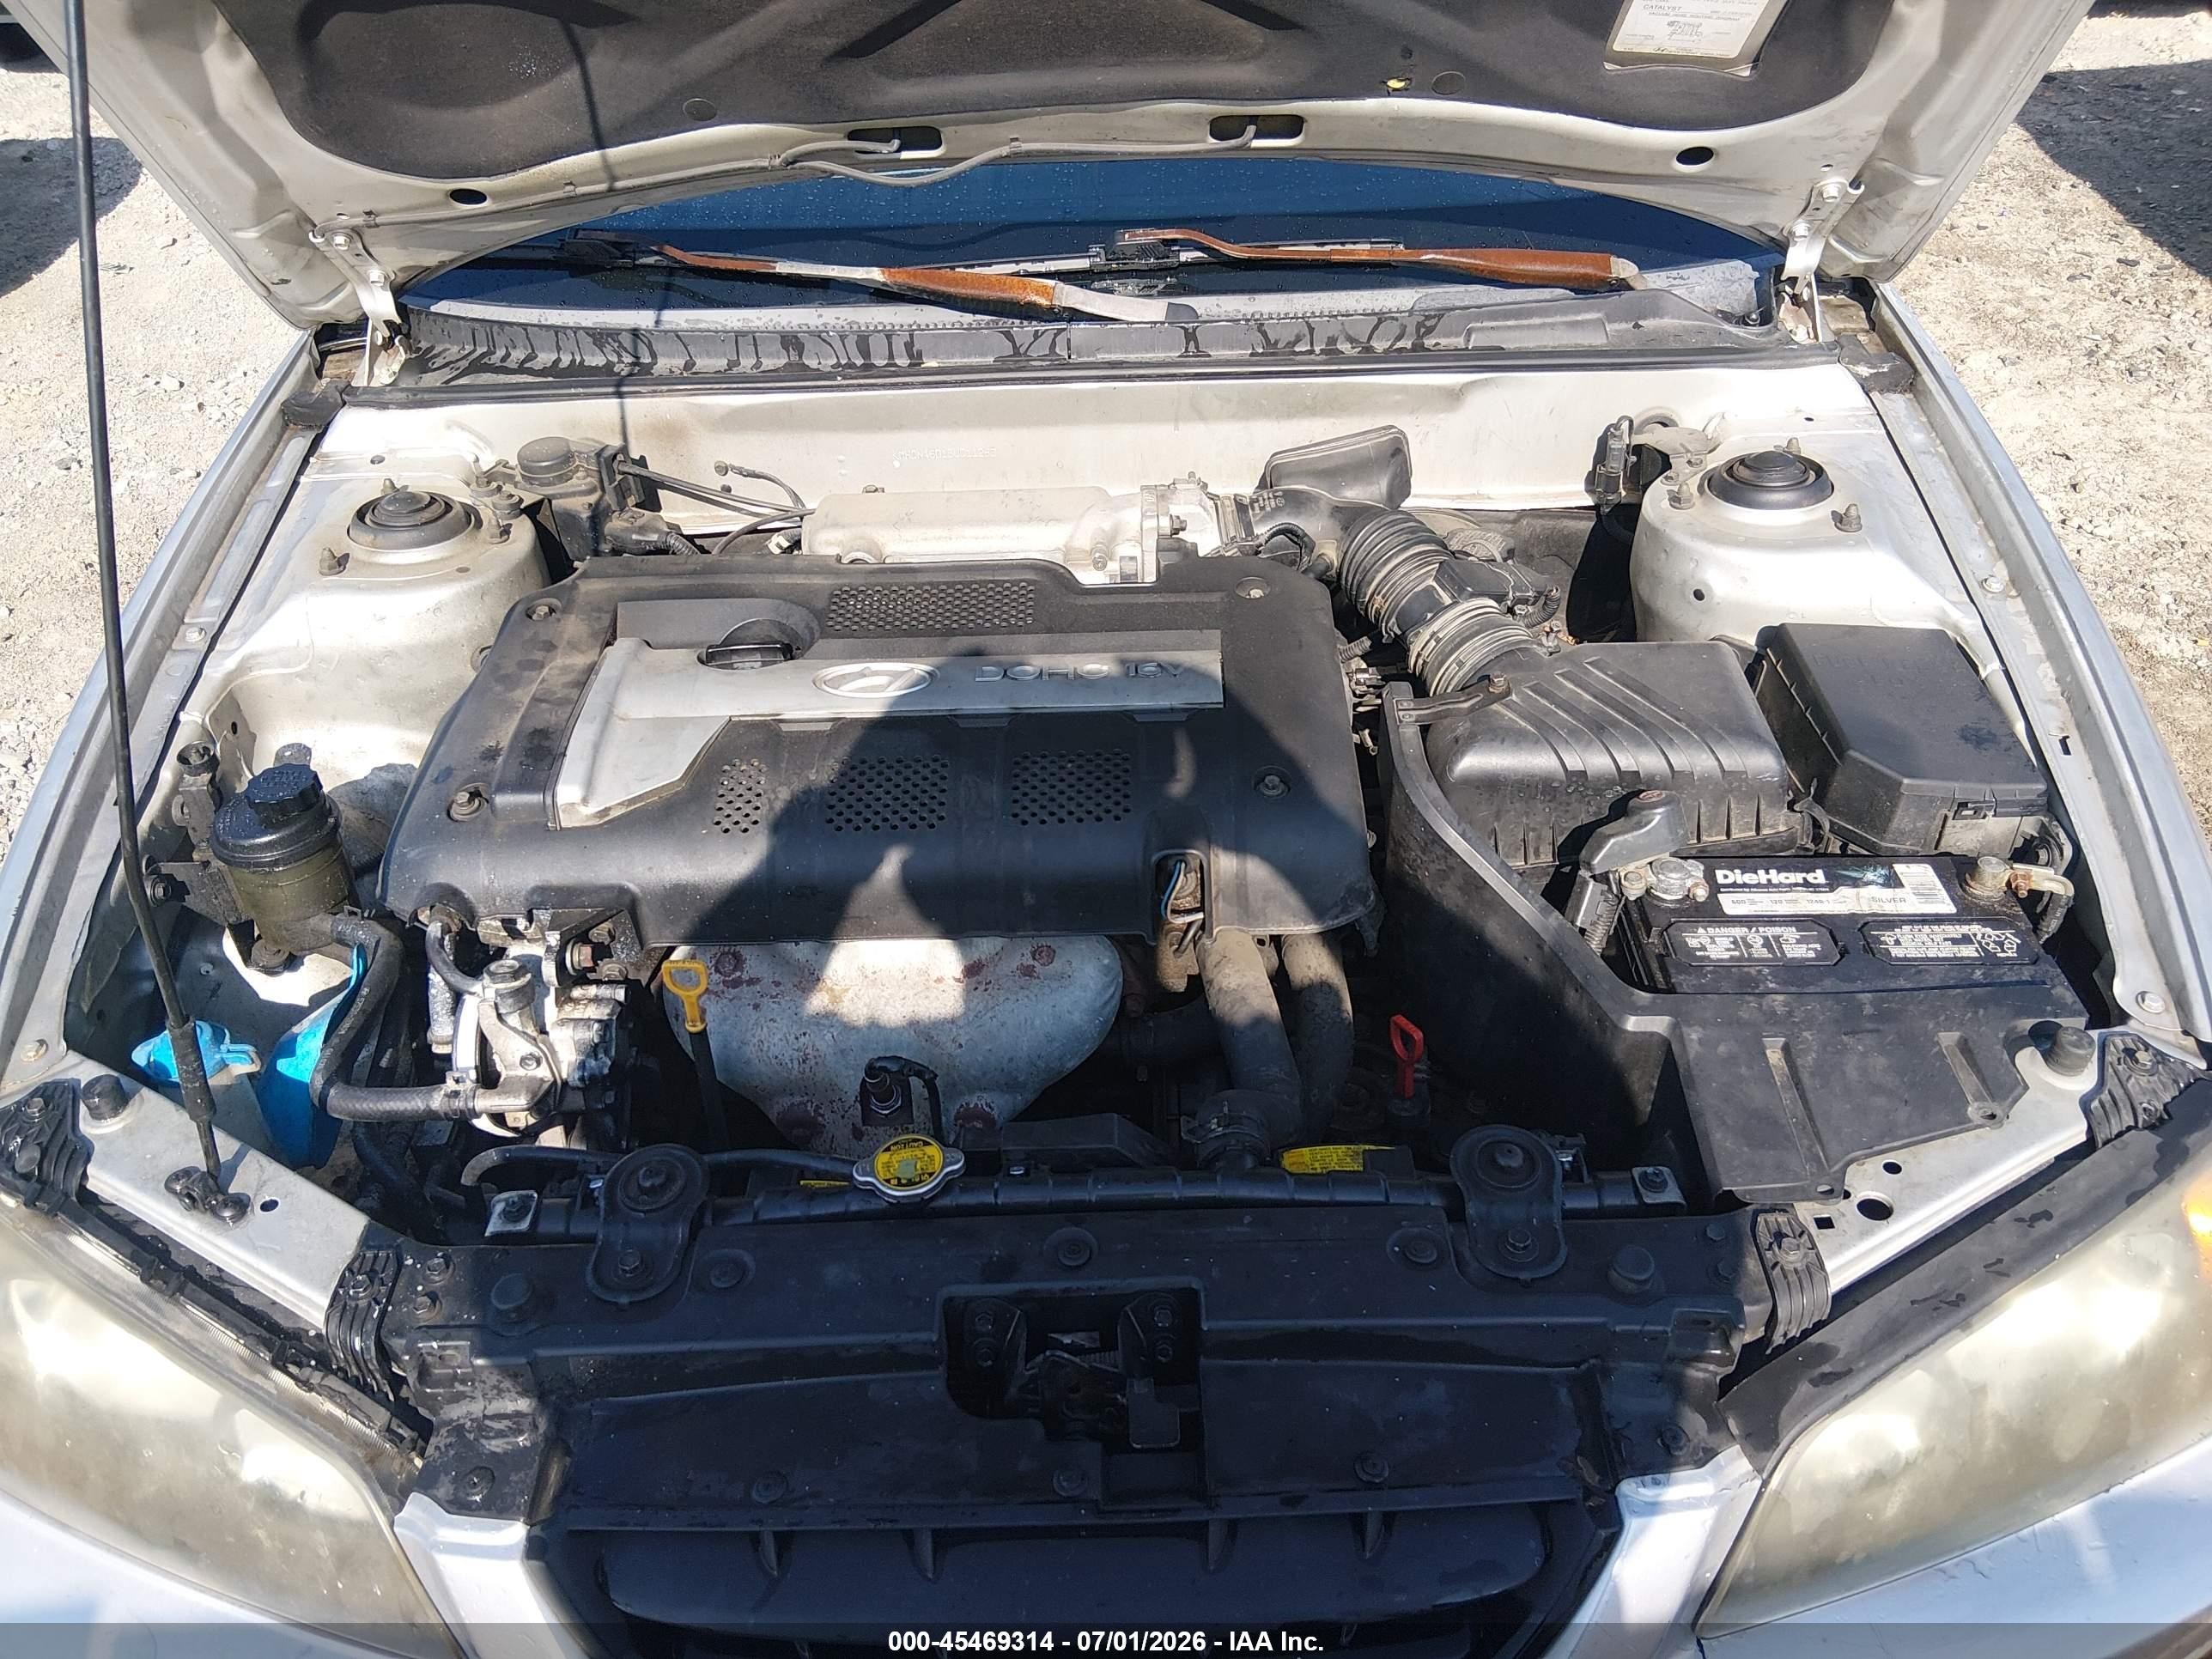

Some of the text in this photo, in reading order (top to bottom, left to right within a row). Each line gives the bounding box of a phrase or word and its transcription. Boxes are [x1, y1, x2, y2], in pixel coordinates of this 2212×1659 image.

[975, 662, 1185, 682] DOHC 16V
[1715, 869, 1826, 884] DieHard
